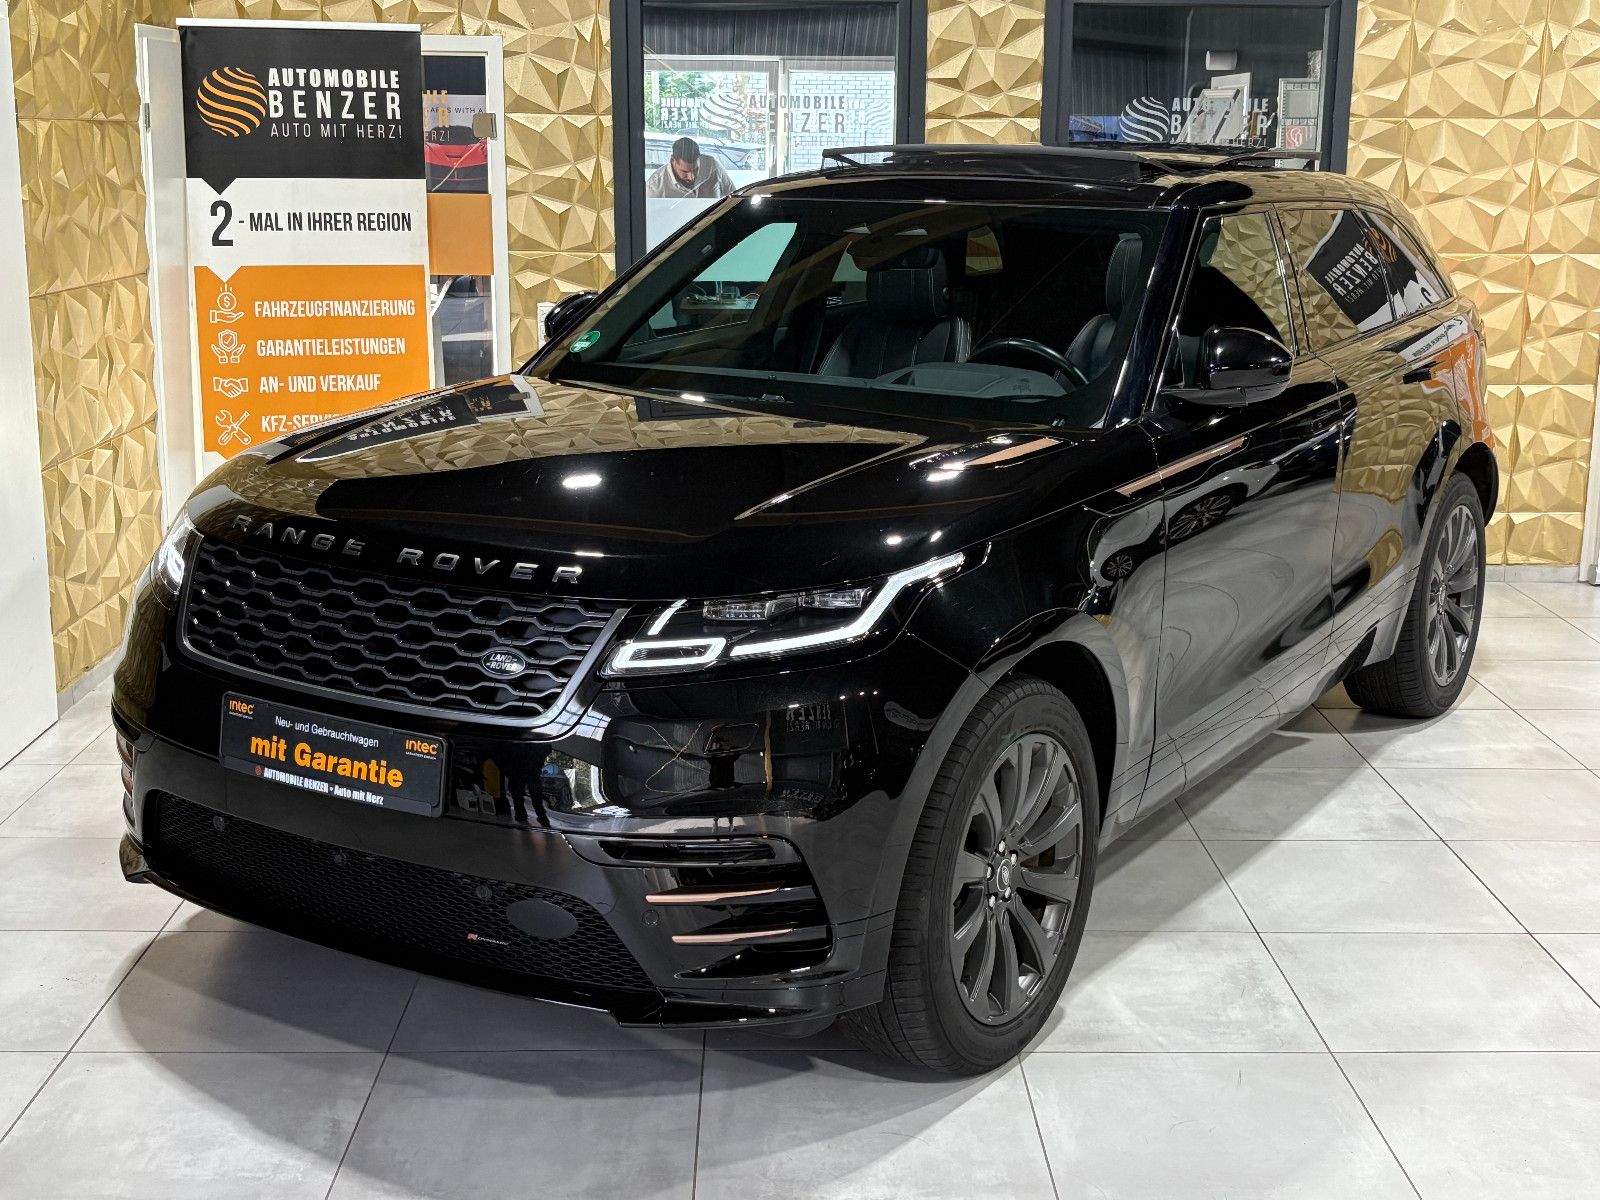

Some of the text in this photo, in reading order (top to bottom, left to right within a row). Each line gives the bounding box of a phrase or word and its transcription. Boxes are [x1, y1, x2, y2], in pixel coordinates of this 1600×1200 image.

[268, 67, 400, 89] AUTOMOBILE
[268, 90, 401, 120] BENZER
[749, 95, 845, 109] AUTOMOBILE
[270, 123, 403, 139] AUTO MIT HERZ!
[210, 200, 234, 247] 2
[249, 212, 284, 232] MAL
[288, 212, 303, 231] IN
[308, 212, 353, 232] IHRER
[357, 212, 412, 232] REGION
[254, 300, 416, 319] FAHRZEUGFINANZIERUNG
[256, 338, 406, 357] GARANTIELEISTUNGEN
[259, 374, 382, 394] AN- UND VERKAUF
[232, 514, 584, 584] RANGE ROVER
[275, 715, 379, 747] Neu- und Gebrauchtwagen
[250, 735, 404, 788] mit Garantie
[263, 767, 384, 805] AUTOMOBILE BENZER Auto mit Herz
